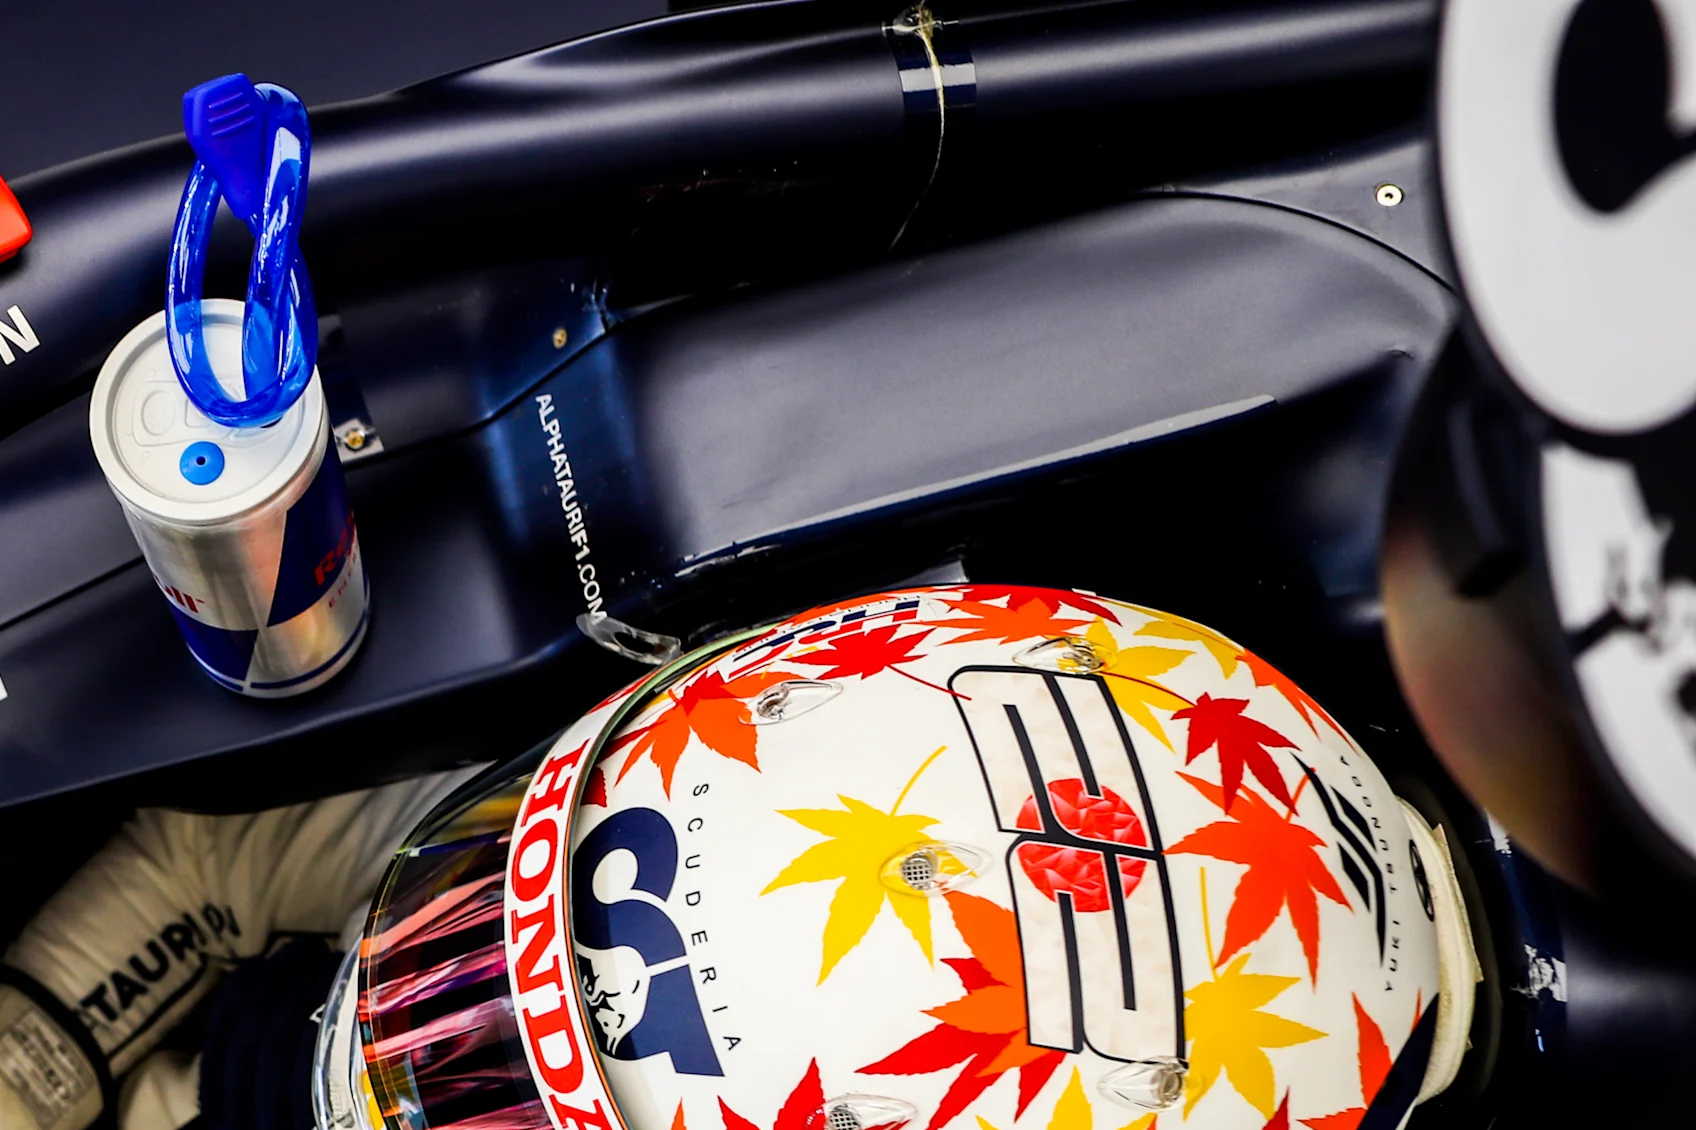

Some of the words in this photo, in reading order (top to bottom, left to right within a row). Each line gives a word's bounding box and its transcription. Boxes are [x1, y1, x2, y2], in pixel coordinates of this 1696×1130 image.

[535, 393, 608, 623] ALPHATAURIF1.COM
[685, 782, 742, 1052] SCUDERIA
[1384, 919, 1401, 993] YUKI
